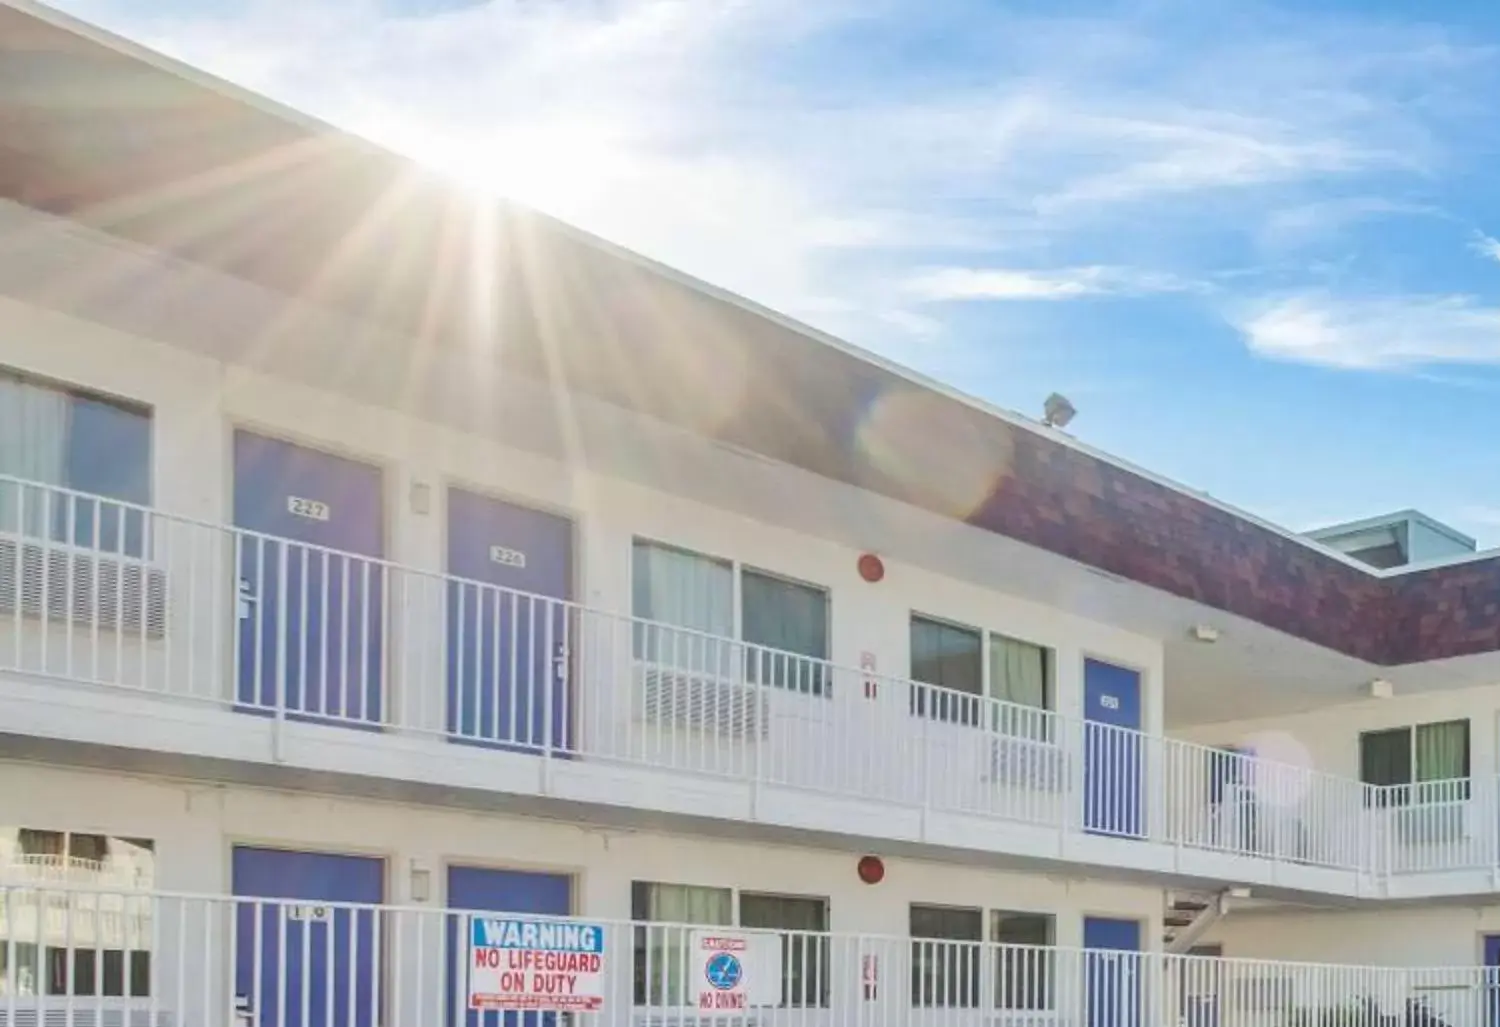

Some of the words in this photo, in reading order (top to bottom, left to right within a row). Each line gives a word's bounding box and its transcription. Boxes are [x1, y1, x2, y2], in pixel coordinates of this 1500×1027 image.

[483, 920, 596, 950] WARNING
[475, 948, 500, 968] NO
[508, 950, 601, 972] LIFEGUARD
[501, 972, 525, 993] ON
[533, 973, 577, 993] DUTY
